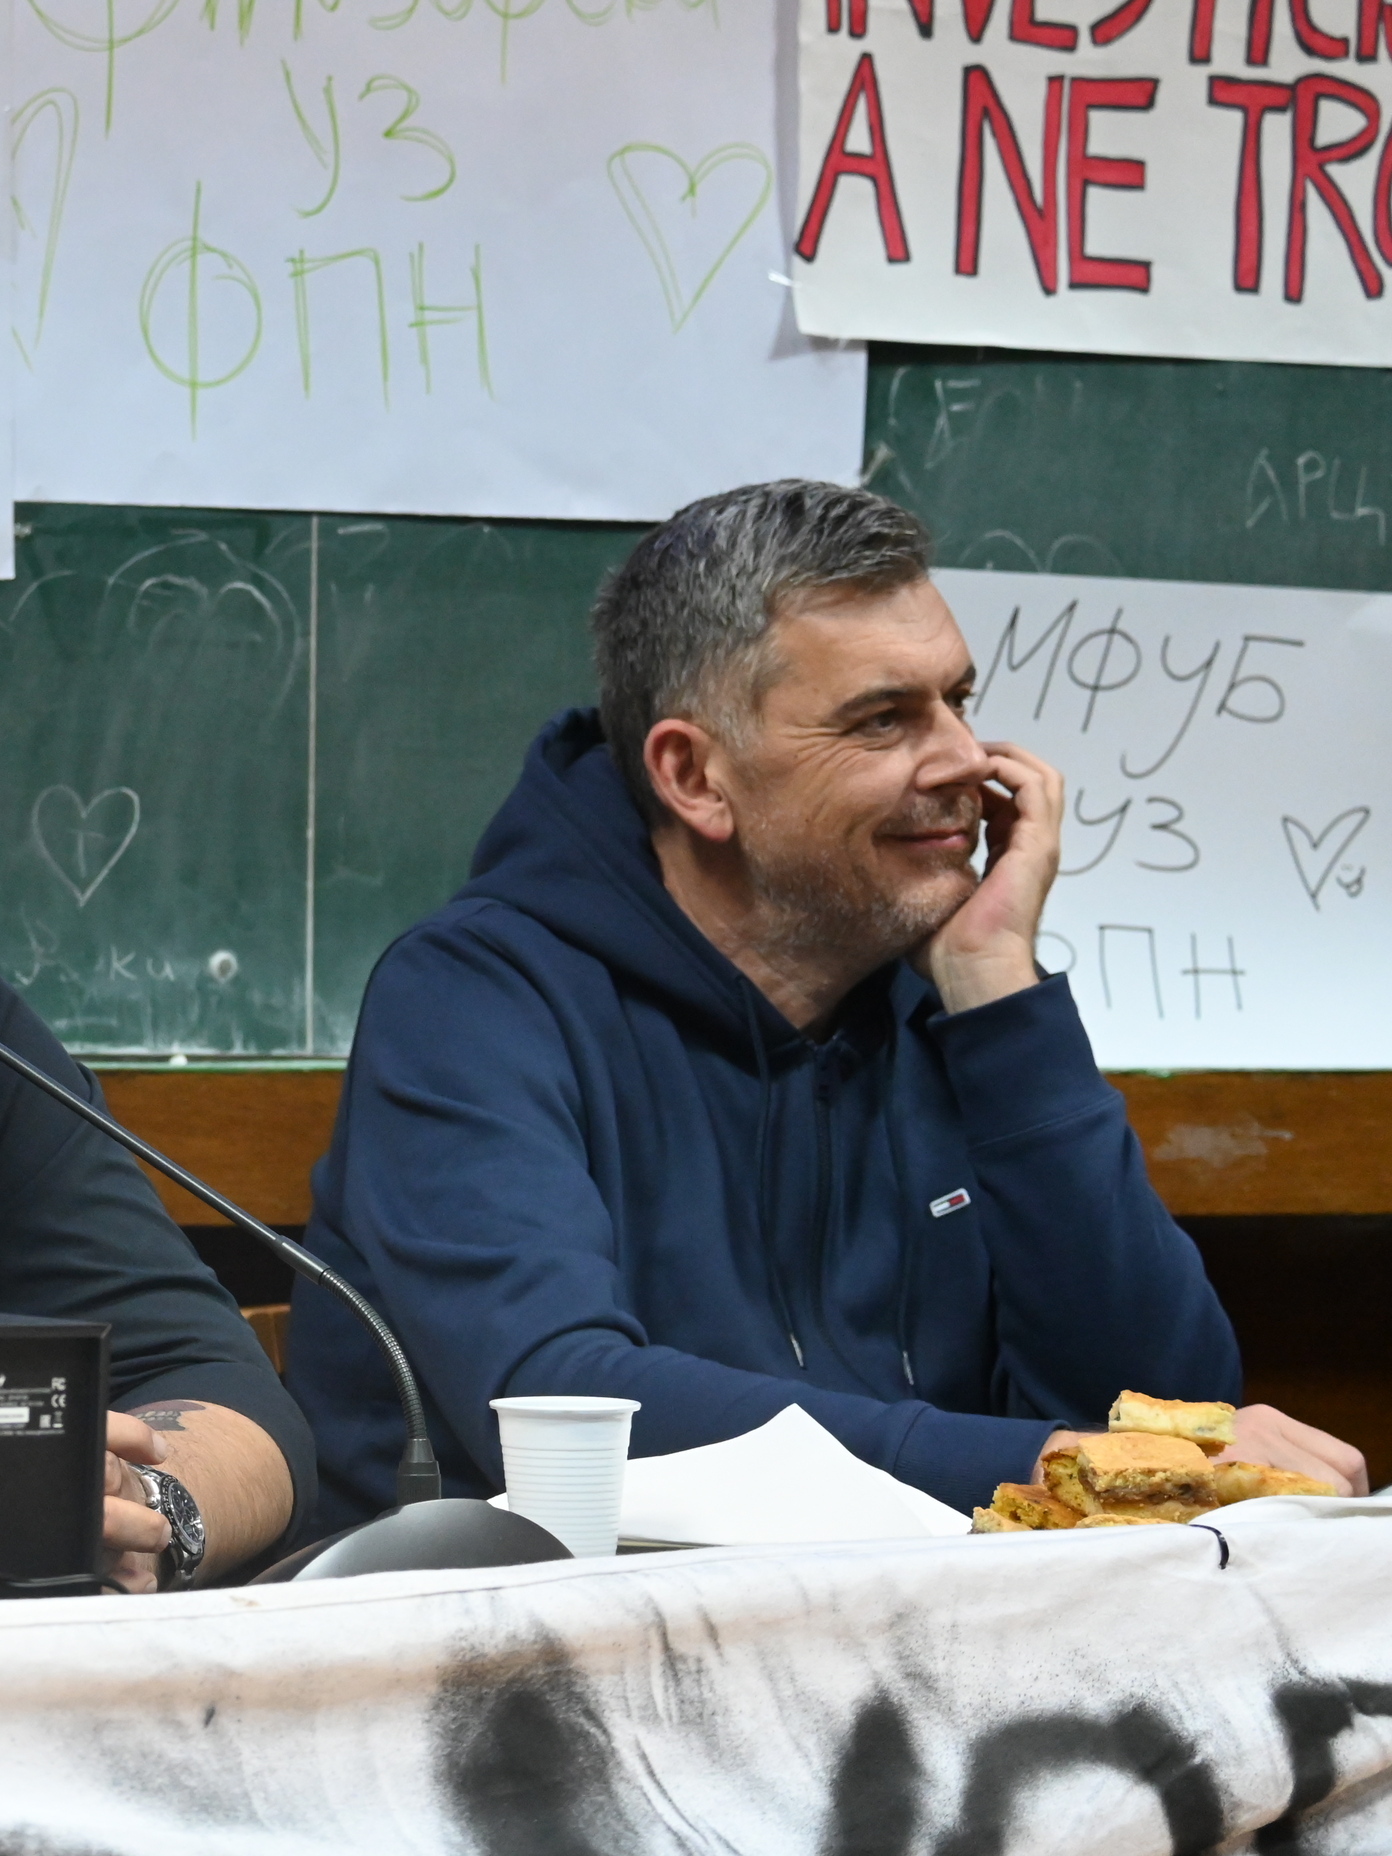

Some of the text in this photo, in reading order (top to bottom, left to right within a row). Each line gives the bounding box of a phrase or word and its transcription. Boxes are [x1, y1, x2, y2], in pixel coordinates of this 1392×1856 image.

[794, 52, 911, 264] A
[954, 64, 1160, 296] NE
[1207, 73, 1392, 304] TR
[139, 179, 495, 442] ФПН
[973, 598, 1305, 779] МФУБ
[1056, 788, 1201, 877] УЗ
